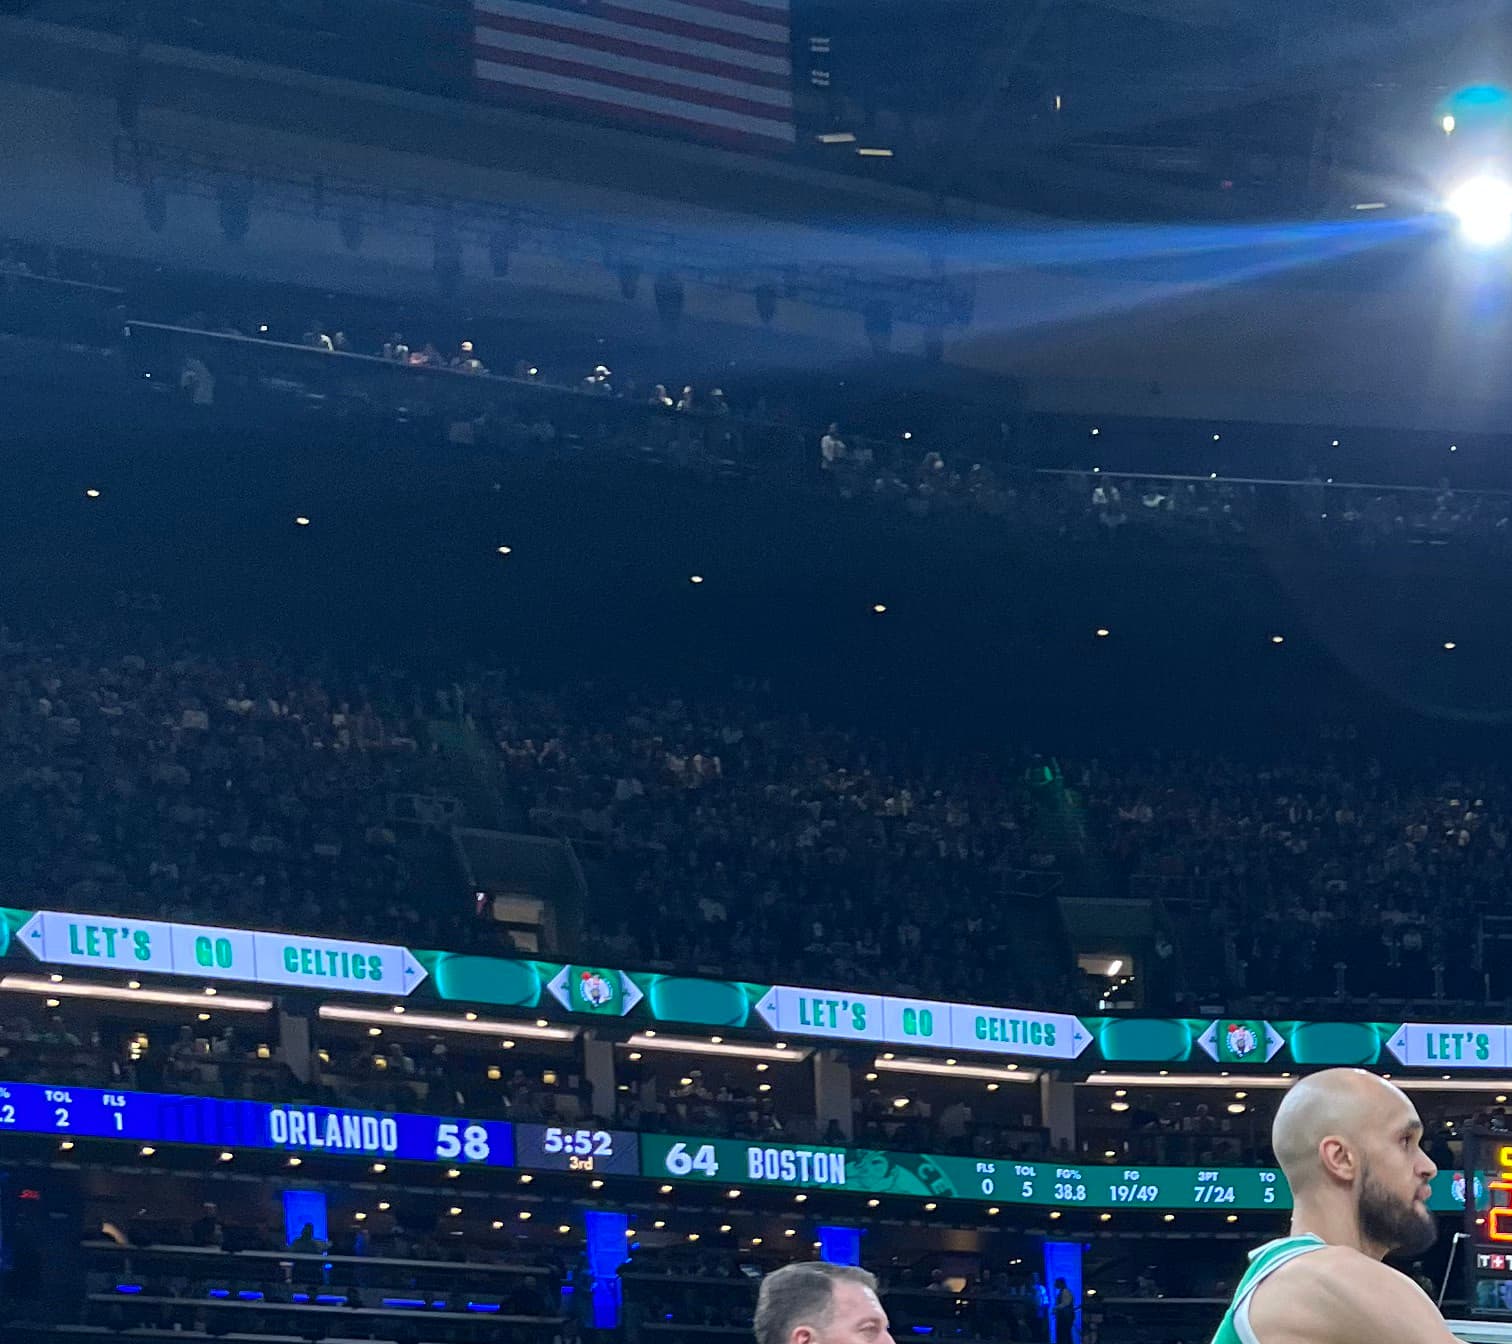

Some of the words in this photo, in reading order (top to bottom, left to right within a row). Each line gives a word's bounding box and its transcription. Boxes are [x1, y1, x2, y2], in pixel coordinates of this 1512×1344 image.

[69, 924, 151, 961] LET'S
[195, 936, 233, 970] GO
[283, 945, 383, 982] CELTICS
[799, 997, 866, 1031] LET'S
[903, 1007, 933, 1037] GO
[975, 1015, 1056, 1048] CELTICS
[1426, 1031, 1490, 1061] LET'S
[45, 1090, 73, 1103] TOL
[102, 1094, 127, 1107] FLS
[55, 1108, 70, 1127] 2
[113, 1112, 124, 1131] 1
[269, 1108, 398, 1152] ORLANDO
[435, 1124, 490, 1160] 58
[544, 1127, 613, 1156] 5:52
[568, 1156, 594, 1171] 3rd
[665, 1142, 719, 1176] 64
[748, 1146, 846, 1185] BOSTON
[976, 1162, 995, 1174] FLS
[1014, 1165, 1037, 1177] TOL
[1124, 1170, 1140, 1181] FG
[1197, 1171, 1219, 1182] 3PT
[1259, 1172, 1276, 1183] TO
[981, 1178, 994, 1195] 0
[1022, 1181, 1034, 1198] 5
[1054, 1184, 1086, 1201] 38.8
[1109, 1184, 1159, 1202] 19/49
[1194, 1186, 1235, 1203] 7/24
[1264, 1187, 1275, 1203] 5
